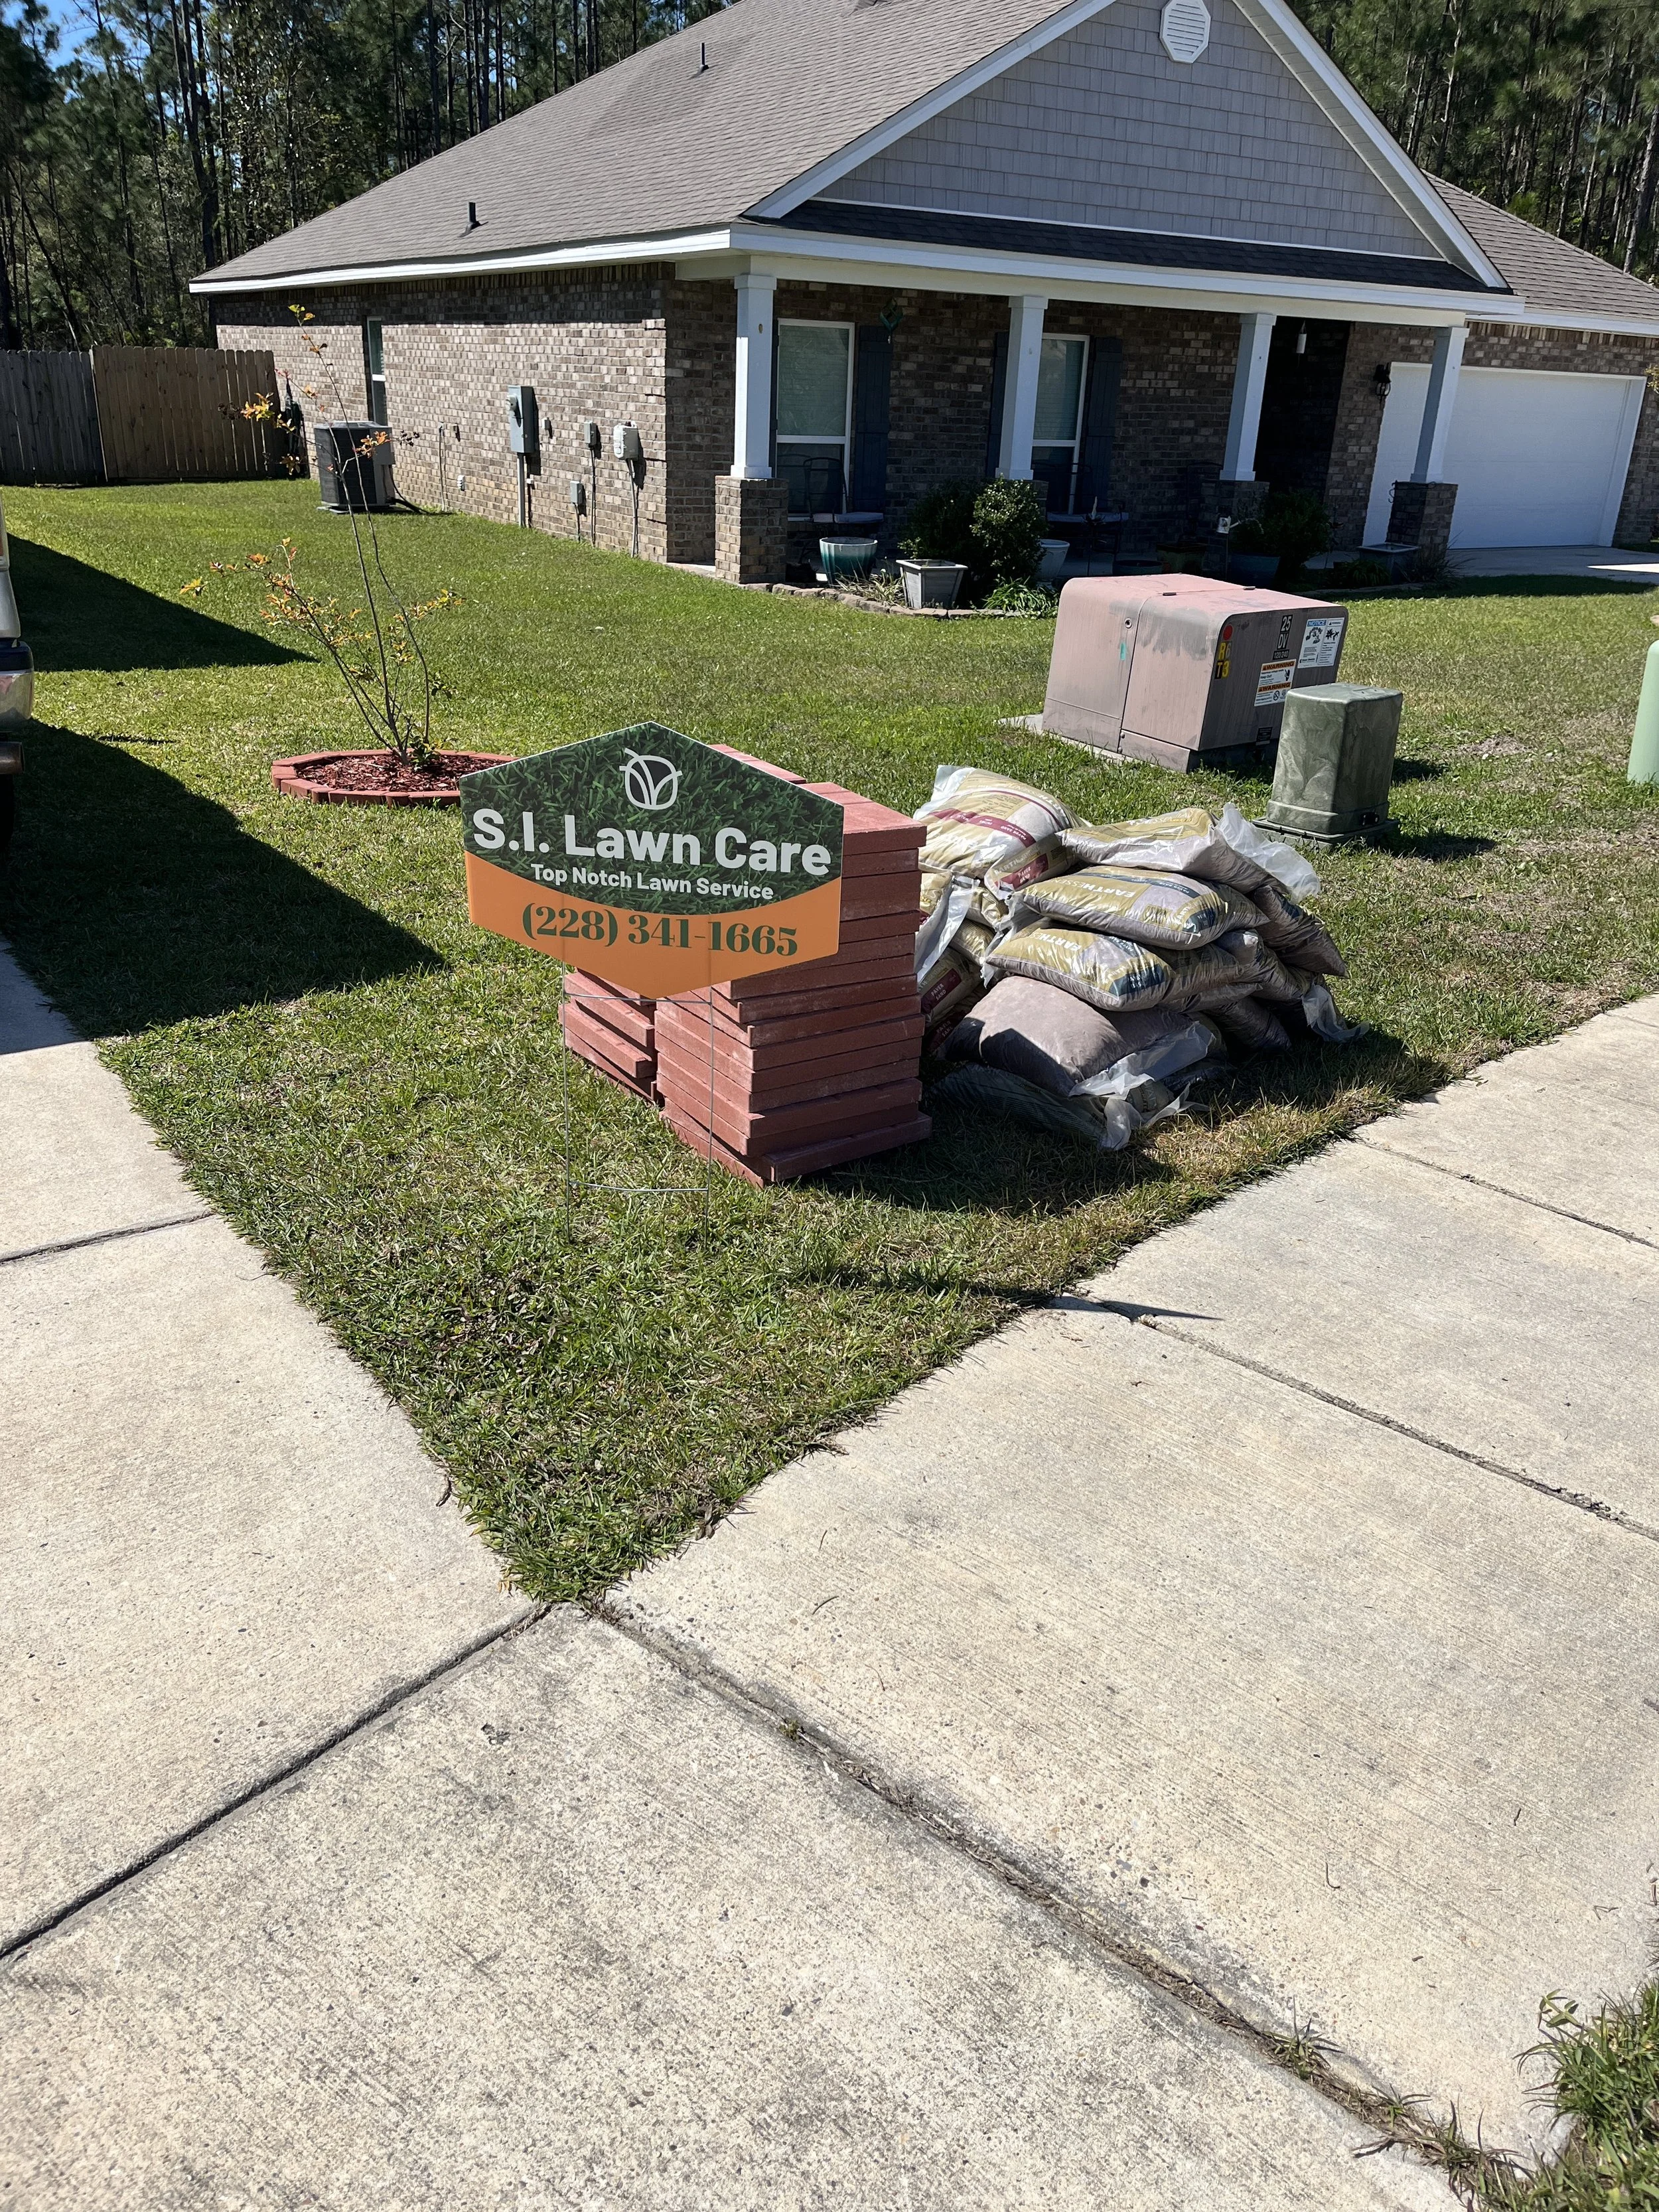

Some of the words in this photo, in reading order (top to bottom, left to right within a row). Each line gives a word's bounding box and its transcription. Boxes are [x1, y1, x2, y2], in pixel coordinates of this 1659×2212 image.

[1281, 616, 1291, 631] 25
[1277, 633, 1289, 649] DV
[1218, 642, 1231, 660] R6
[1217, 660, 1230, 678] T3
[1267, 661, 1294, 670] WARNING
[1263, 682, 1290, 691] WARNING
[473, 808, 549, 854] S.I.
[564, 814, 701, 866] Lawn
[715, 826, 831, 876] Care
[531, 863, 568, 887] Top
[572, 867, 632, 888] Notch
[637, 872, 691, 894] Lawn
[696, 877, 774, 900] Service
[522, 903, 618, 948] (228)
[628, 915, 798, 956] 341-1665
[930, 983, 944, 996] PAVER
[936, 989, 946, 1001] SAND
